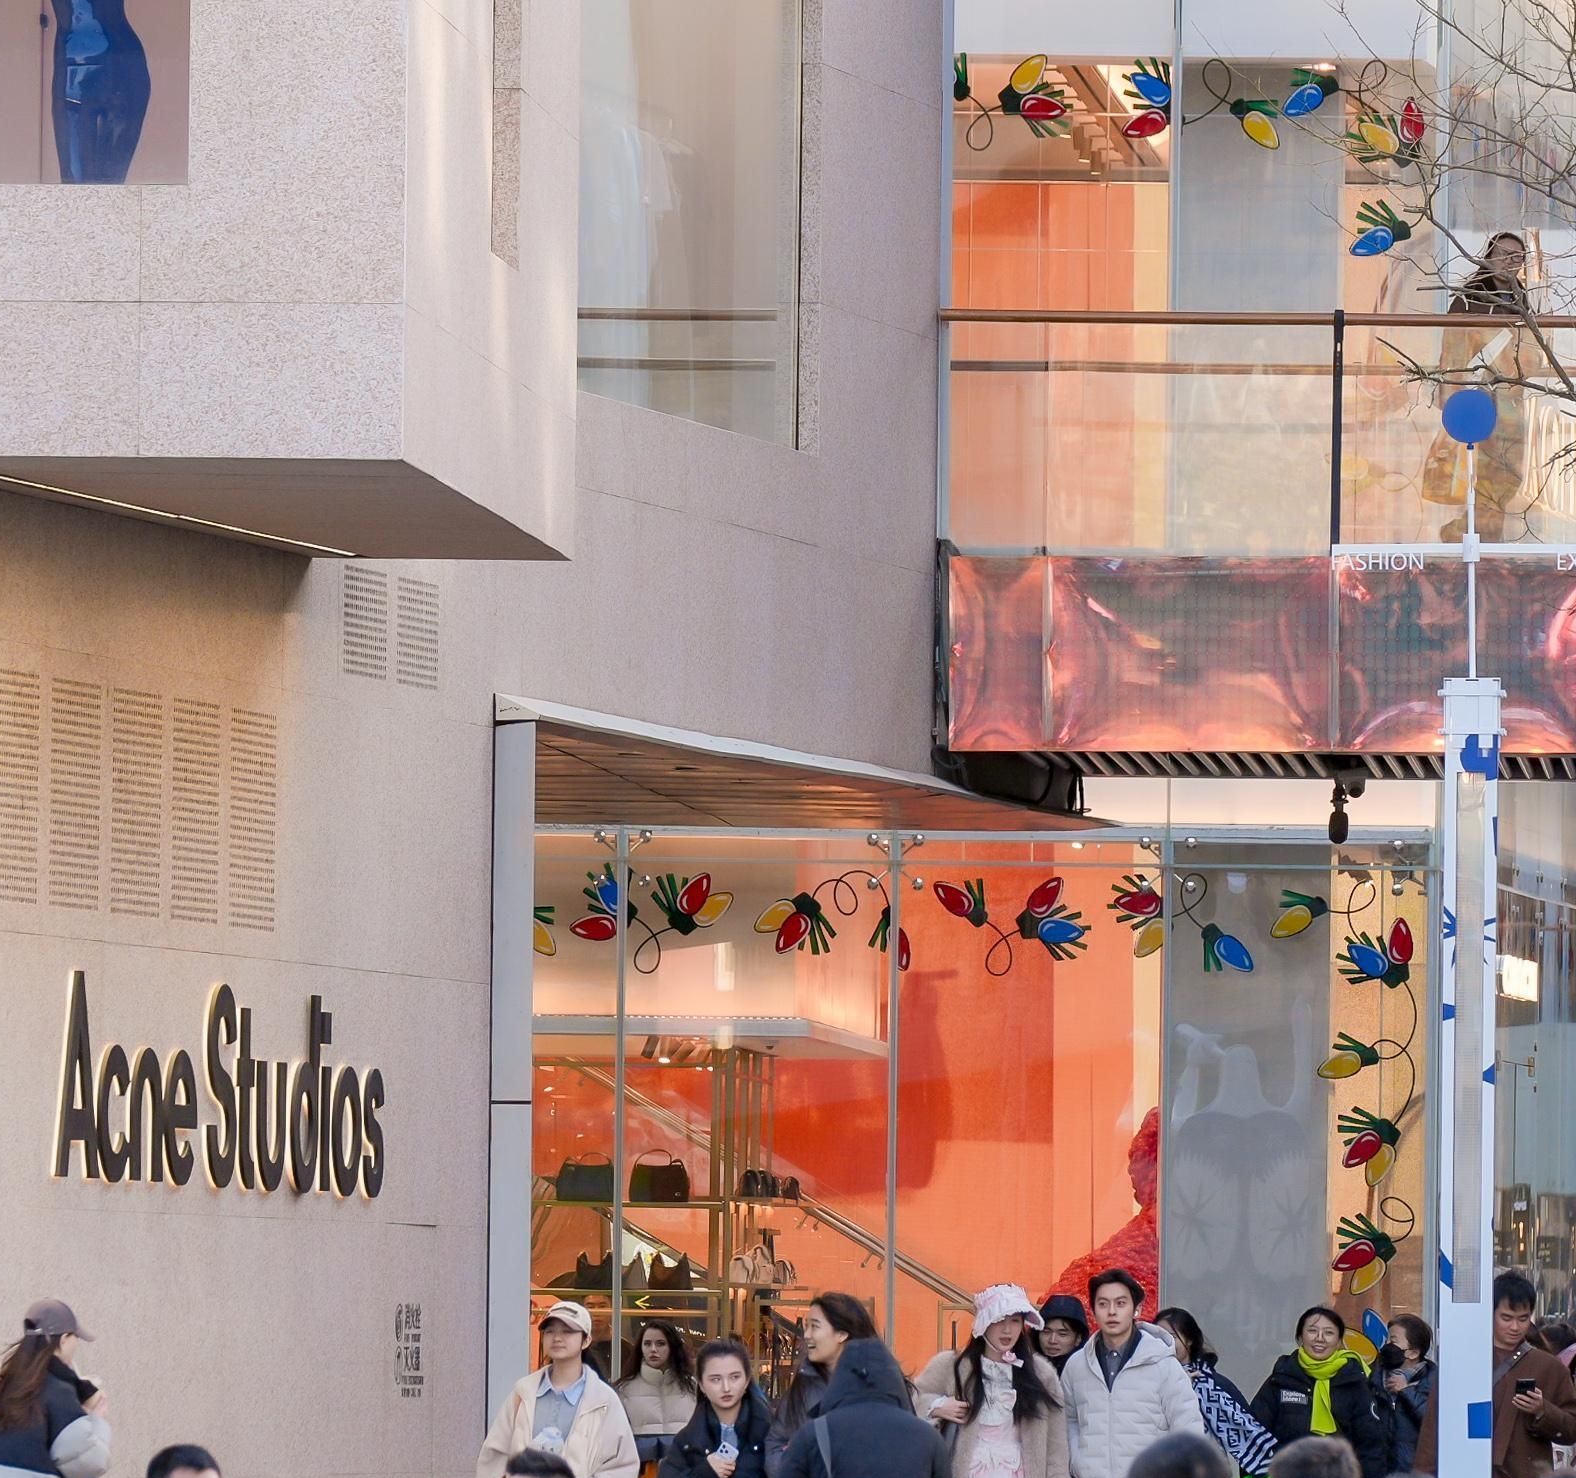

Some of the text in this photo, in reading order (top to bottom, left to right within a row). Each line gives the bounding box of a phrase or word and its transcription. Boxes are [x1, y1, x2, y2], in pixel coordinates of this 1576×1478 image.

[1331, 553, 1424, 571] FASHION
[52, 970, 385, 1199] Acne Studios
